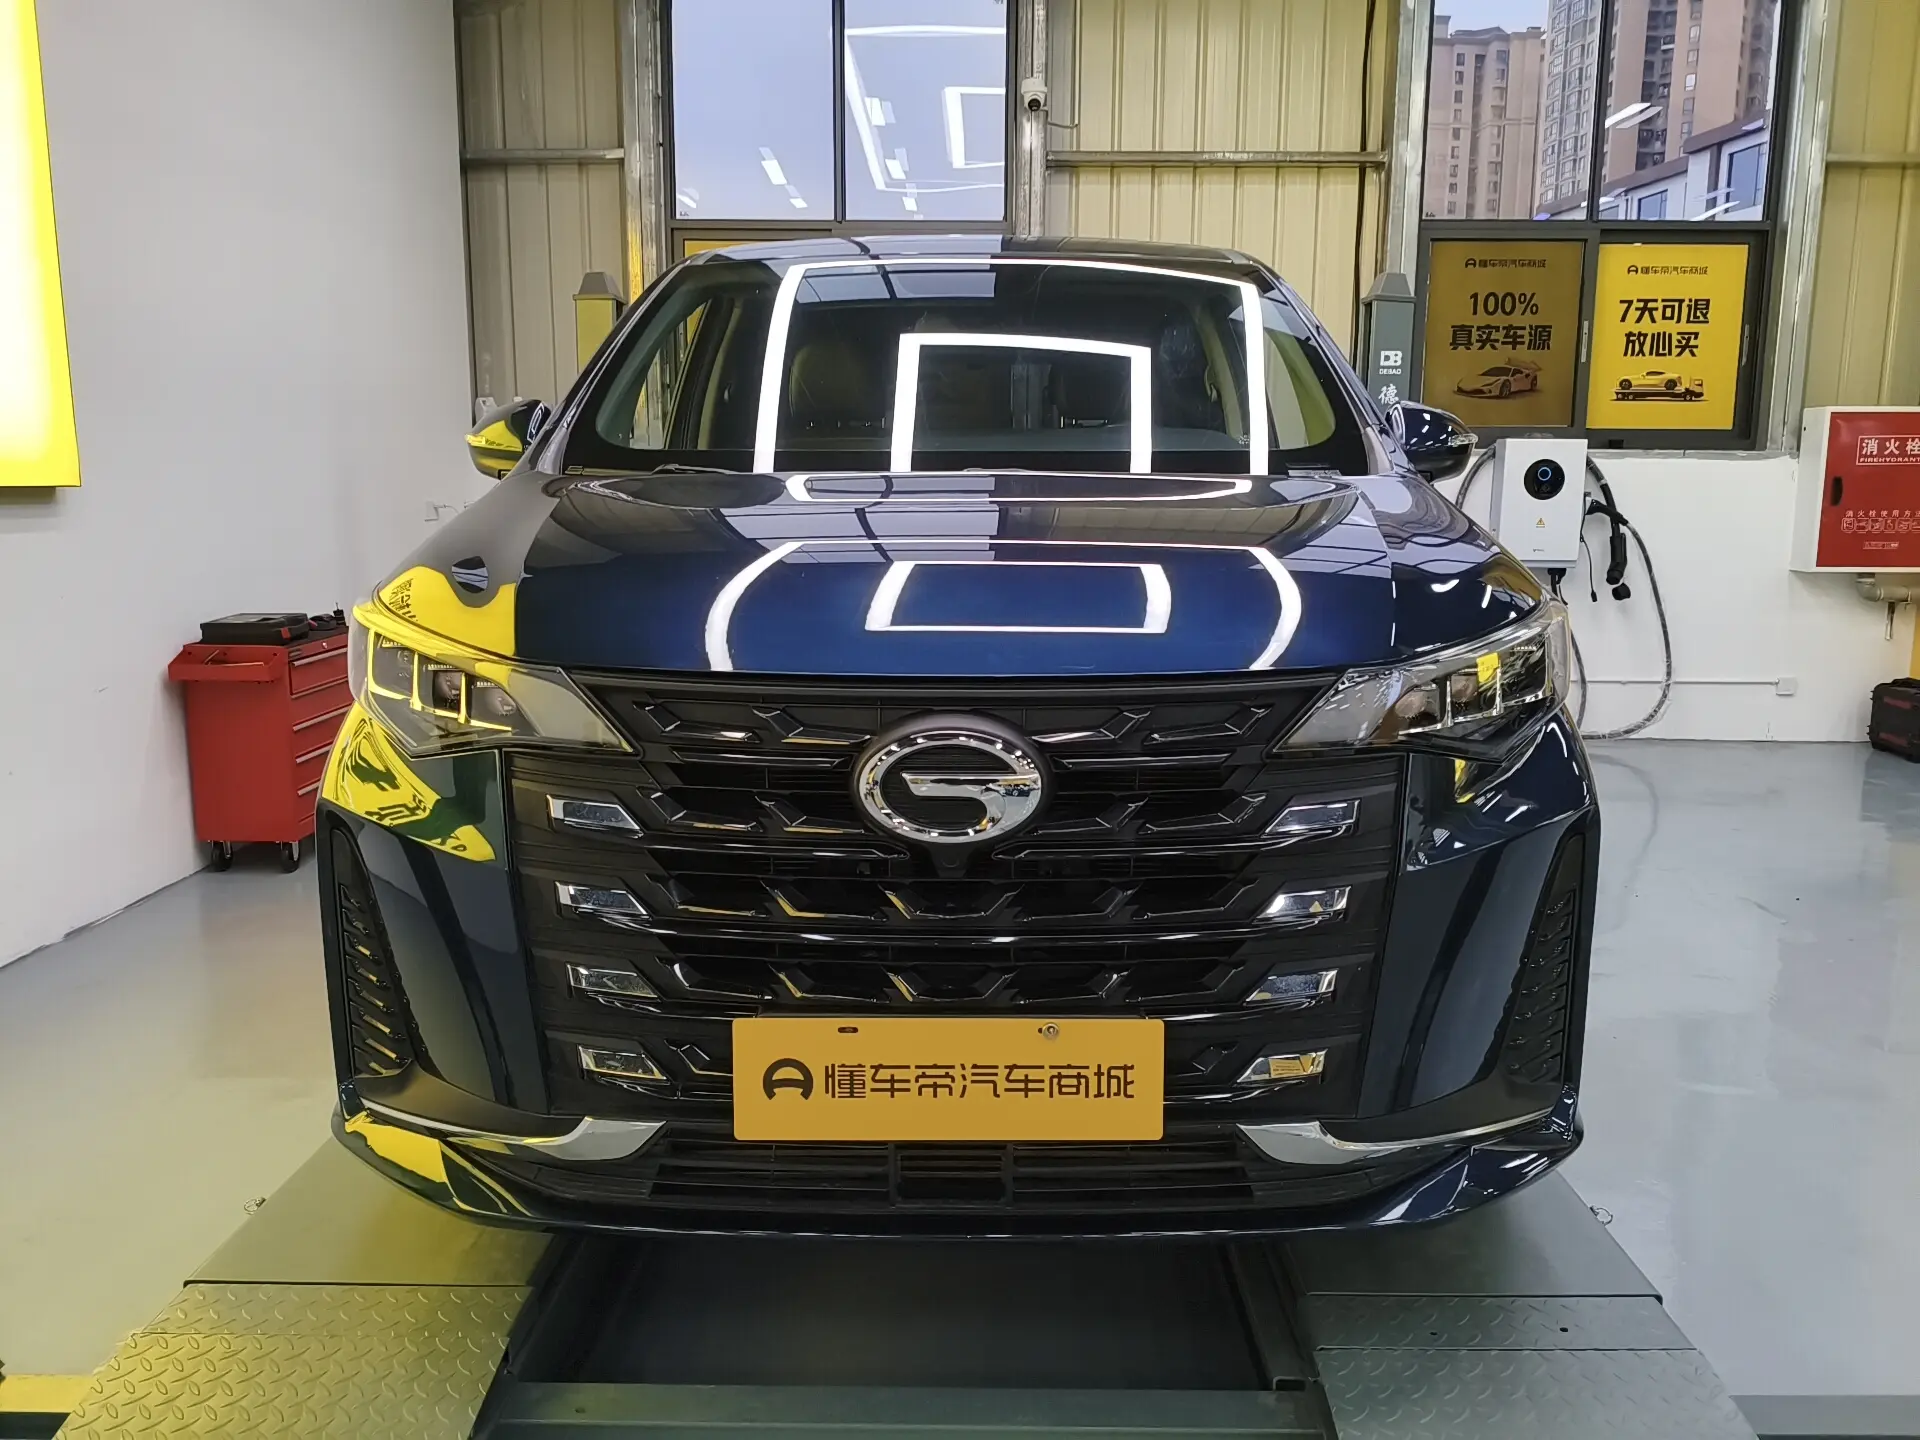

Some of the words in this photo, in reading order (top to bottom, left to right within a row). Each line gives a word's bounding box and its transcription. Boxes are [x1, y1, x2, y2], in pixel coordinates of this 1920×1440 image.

[1469, 291, 1539, 316] 100%
[1619, 298, 1711, 324] 7天可退
[1449, 324, 1553, 351] 真实车源
[1623, 331, 1700, 357] 放心买
[1378, 383, 1399, 405] 德
[1862, 438, 1920, 455] 消火栓
[824, 1063, 1135, 1099] 懂车帝汽车商城
